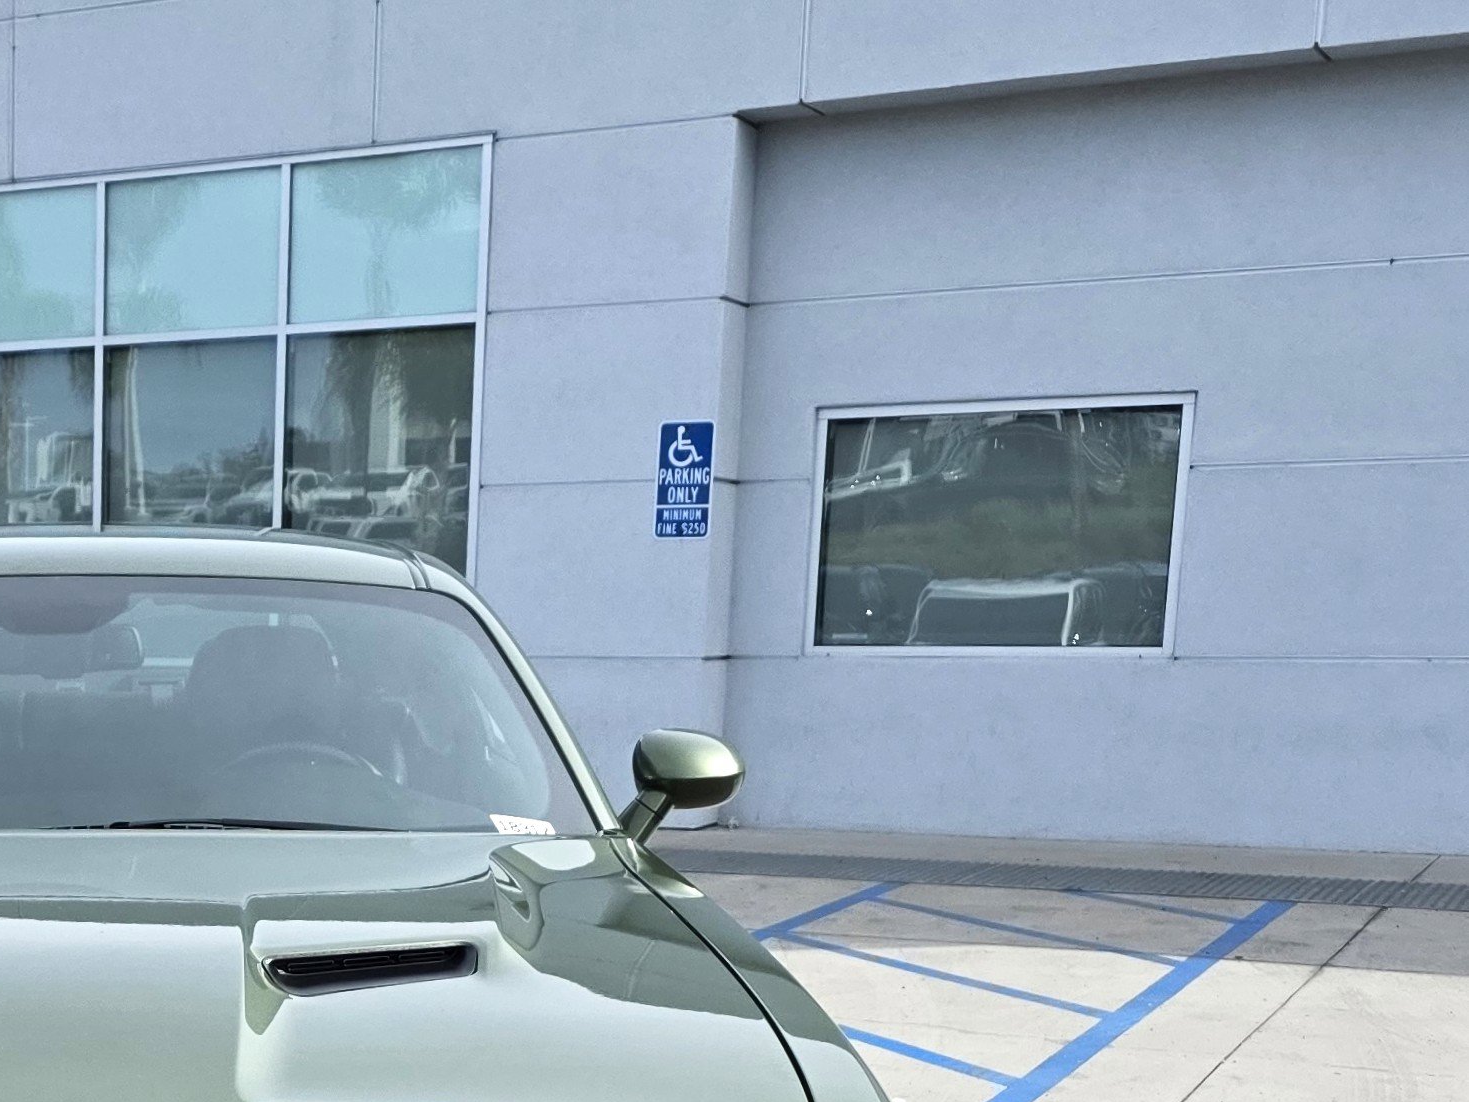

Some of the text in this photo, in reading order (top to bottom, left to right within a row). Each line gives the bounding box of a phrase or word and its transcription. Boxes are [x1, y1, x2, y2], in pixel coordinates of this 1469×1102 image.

[659, 467, 710, 484] PARKING
[667, 486, 699, 503] ONLY
[663, 509, 702, 520] MINIMUM
[657, 522, 706, 534] FINE $250
